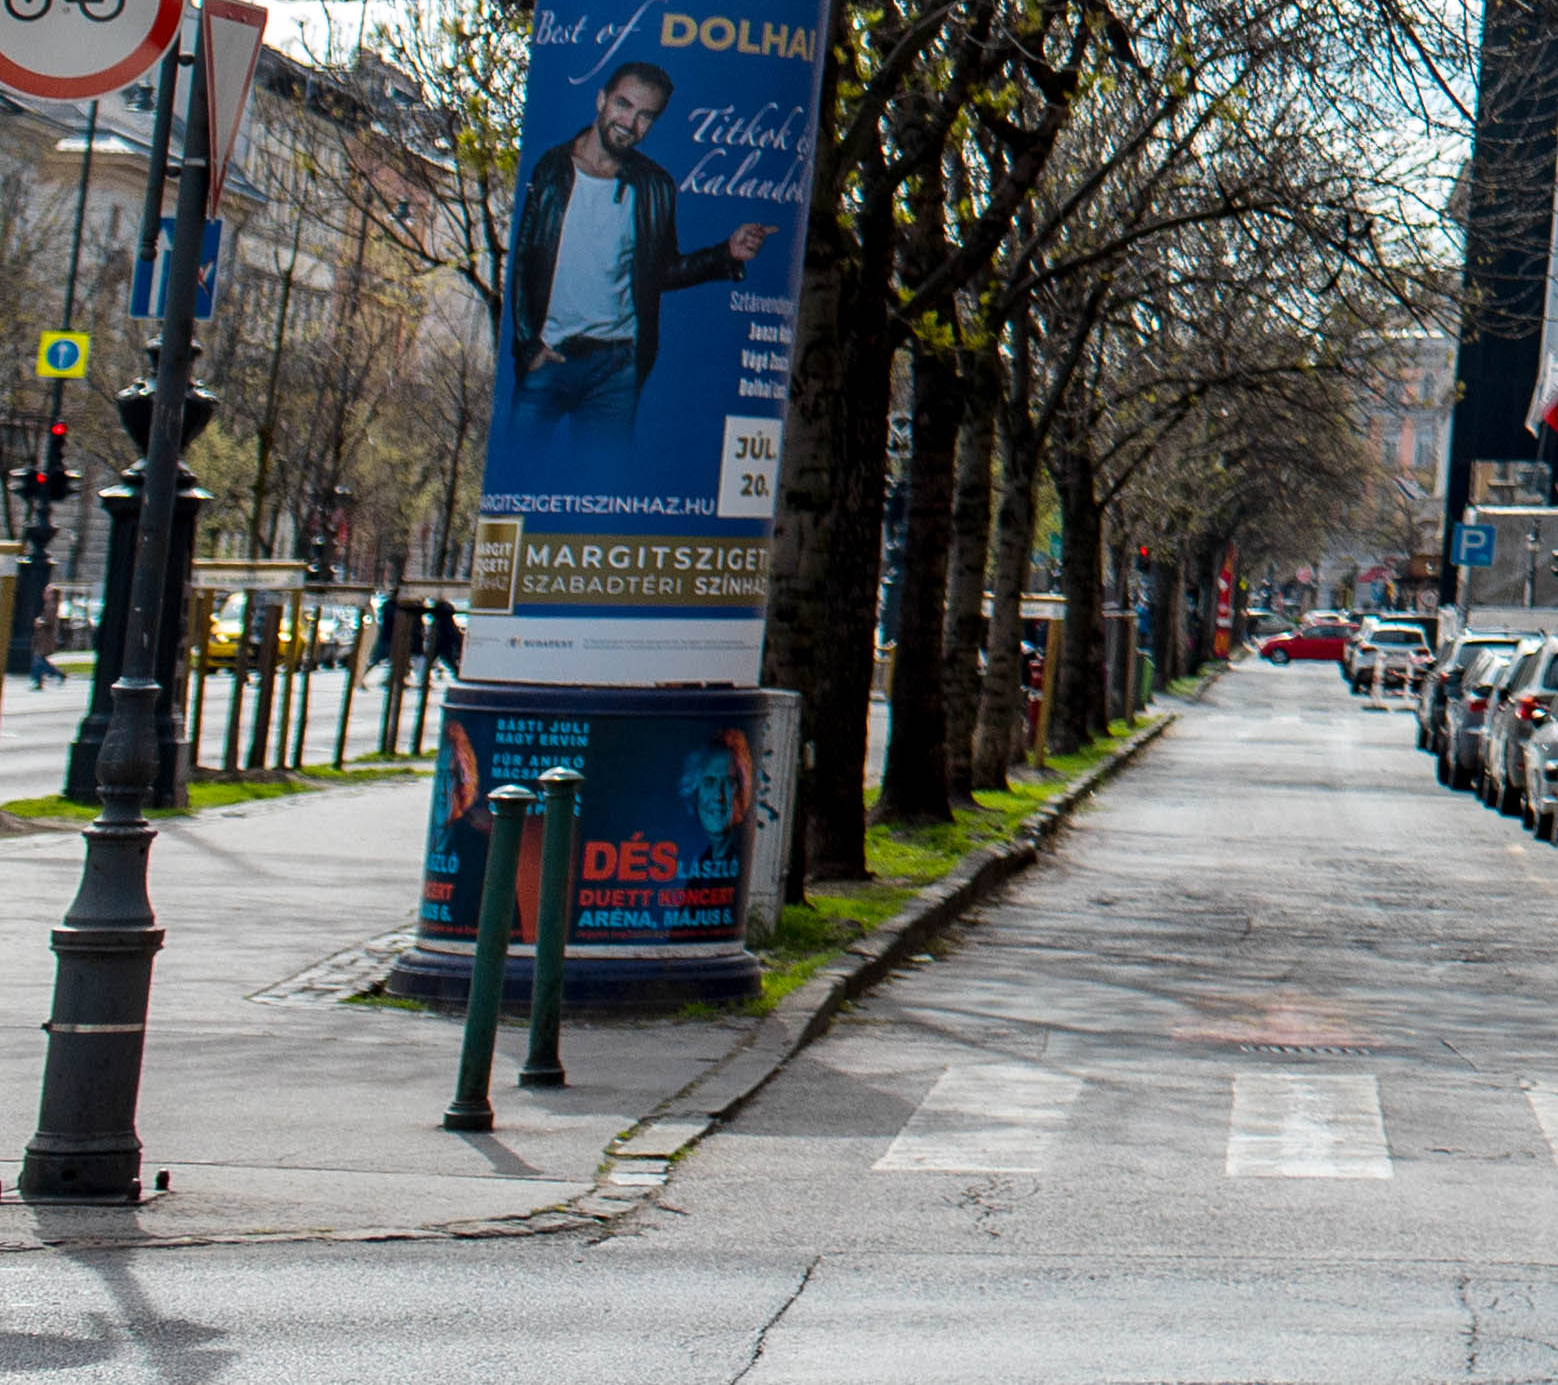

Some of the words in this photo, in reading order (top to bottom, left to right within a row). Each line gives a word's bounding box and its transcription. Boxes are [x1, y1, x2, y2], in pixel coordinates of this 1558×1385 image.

[535, 9, 587, 46] Best
[688, 102, 804, 151] Titkok
[740, 473, 770, 498] 20.
[480, 493, 715, 516] ARGITSZIGETISZINHAZ.HU
[1458, 530, 1486, 561] P
[522, 573, 683, 597] SZABADTÉRI
[490, 765, 543, 780] MÁCSA
[582, 831, 679, 882] DÉS
[677, 854, 740, 879] LÁSZLÓ
[578, 888, 653, 907] DUETT
[658, 887, 735, 907] KONCERT
[577, 907, 658, 930] ARÉNA,
[663, 908, 721, 928] MÁJUS
